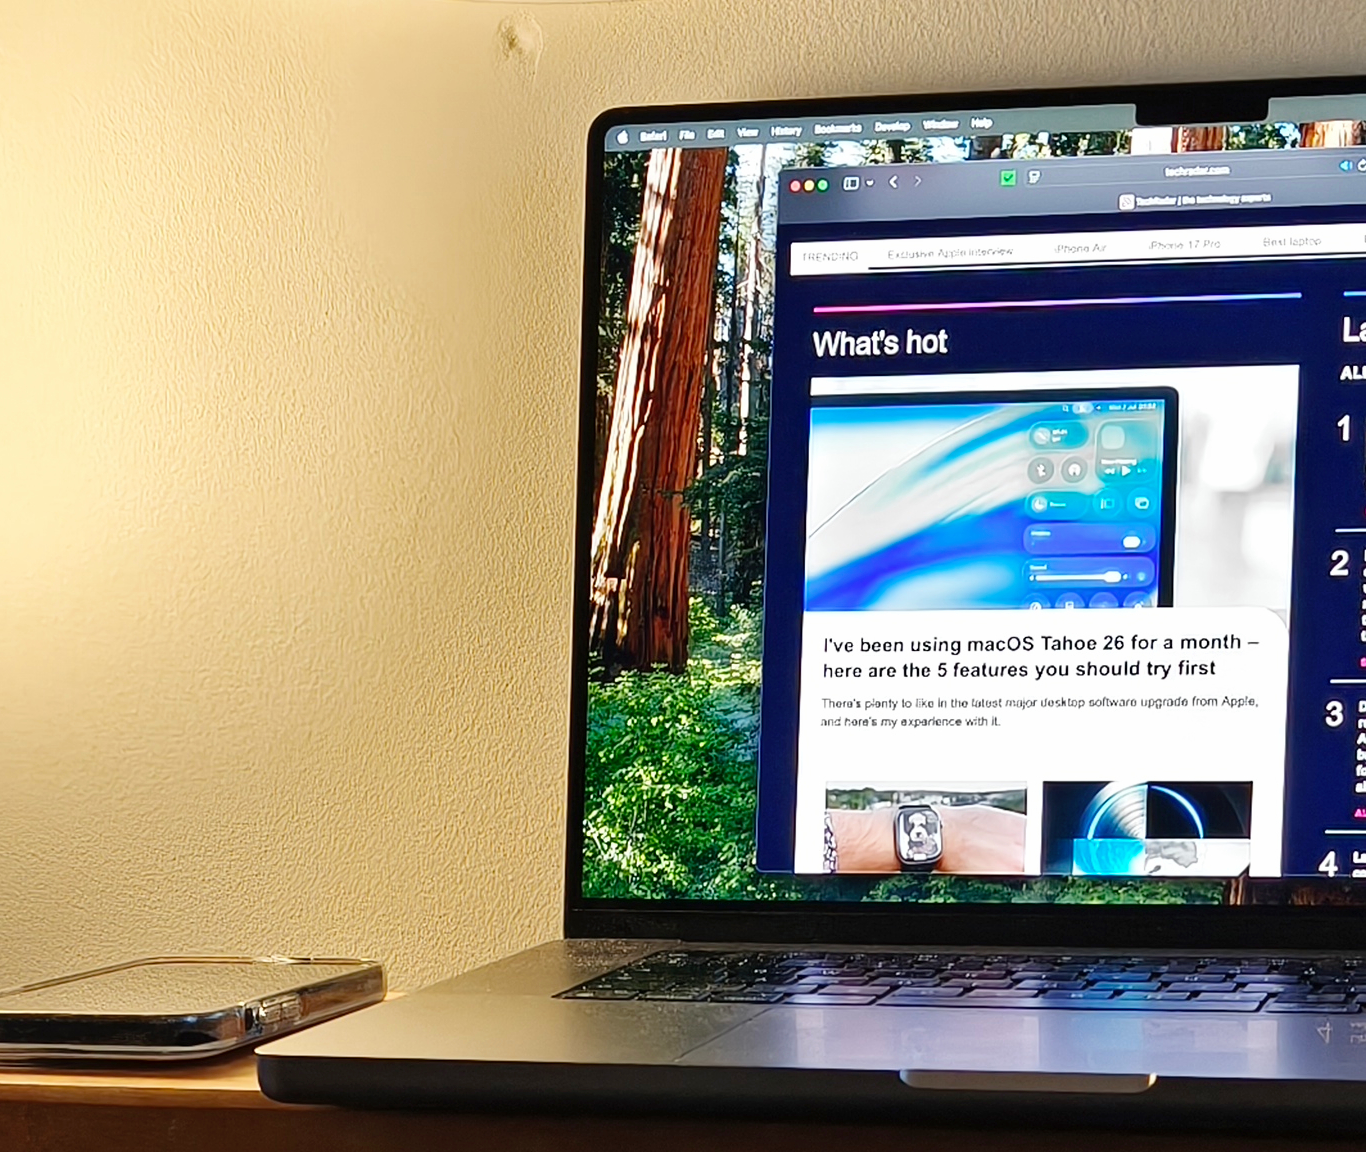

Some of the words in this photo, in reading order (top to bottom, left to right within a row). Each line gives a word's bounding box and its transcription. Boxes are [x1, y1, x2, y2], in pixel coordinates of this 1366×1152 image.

[813, 329, 899, 357] What's
[906, 329, 948, 354] hot
[1337, 415, 1351, 441] 1
[1330, 550, 1349, 576] 2
[824, 638, 854, 653] I've
[860, 637, 904, 653] been
[910, 637, 961, 655] using
[967, 636, 1035, 651] macOS
[1041, 635, 1097, 651] Tahoe
[1103, 635, 1125, 651] 26
[1131, 634, 1157, 650] for
[1163, 638, 1173, 649] a
[1180, 634, 1241, 650] month
[823, 663, 862, 678] here
[868, 666, 897, 678] are
[902, 663, 931, 678] the
[937, 663, 947, 678] 5
[953, 662, 1028, 678] features
[1035, 664, 1069, 681] you
[1075, 661, 1140, 676] should
[1146, 661, 1172, 680] try
[1178, 660, 1216, 676] first
[822, 698, 861, 709] There's
[915, 698, 934, 708] like
[937, 698, 947, 708] in
[950, 698, 968, 708] the
[1041, 697, 1085, 709] desktop
[1088, 696, 1137, 708] software
[1141, 697, 1189, 709] upgrade
[1192, 695, 1218, 707] from
[1325, 701, 1344, 727] 3
[880, 718, 897, 729] my
[901, 717, 962, 729] experience
[965, 716, 988, 727] with
[1318, 851, 1338, 878] 4
